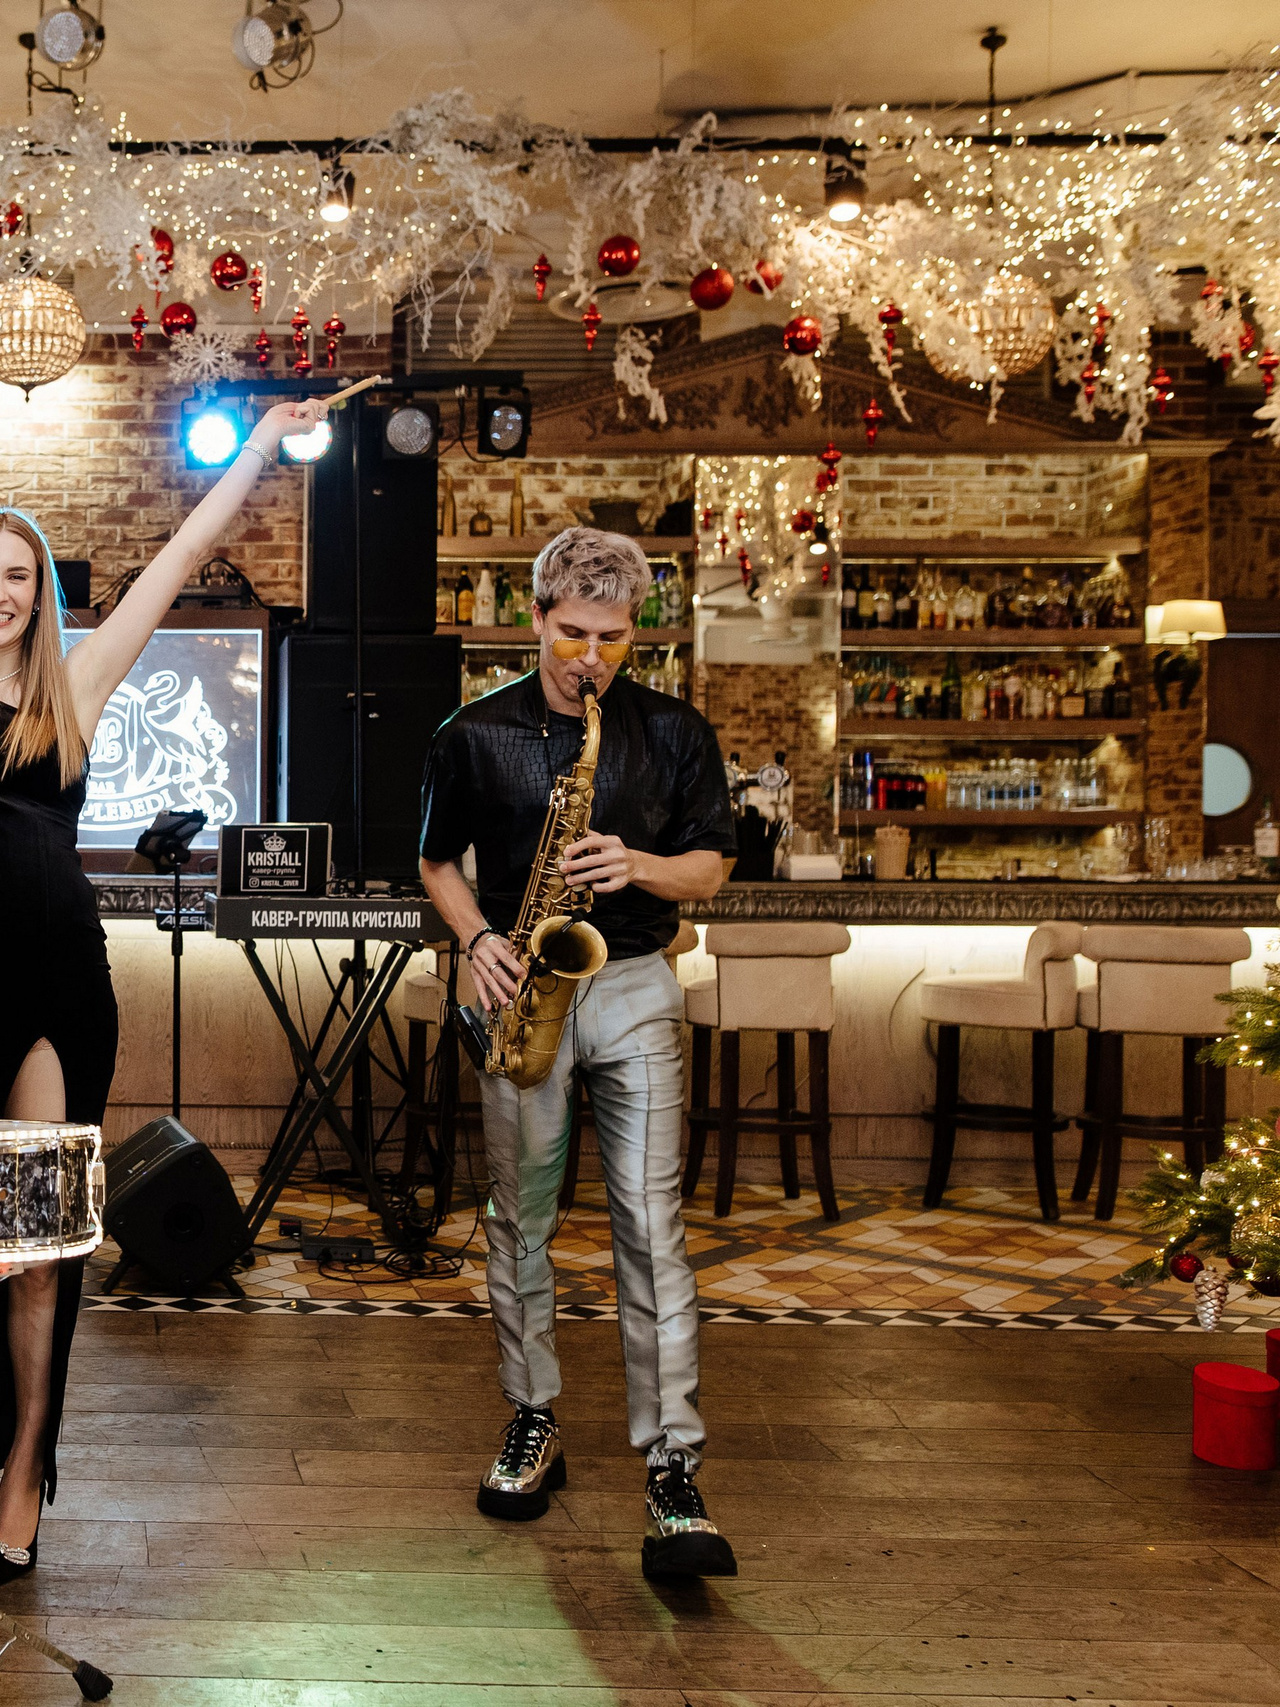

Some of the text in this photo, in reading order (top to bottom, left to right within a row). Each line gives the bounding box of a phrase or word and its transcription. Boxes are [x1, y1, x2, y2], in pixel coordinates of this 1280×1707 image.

[248, 851, 302, 866] KRISTALL
[160, 914, 206, 926] AESI
[251, 910, 421, 929] КАВЕР-ГРУППА КРИСТАЛЛ
